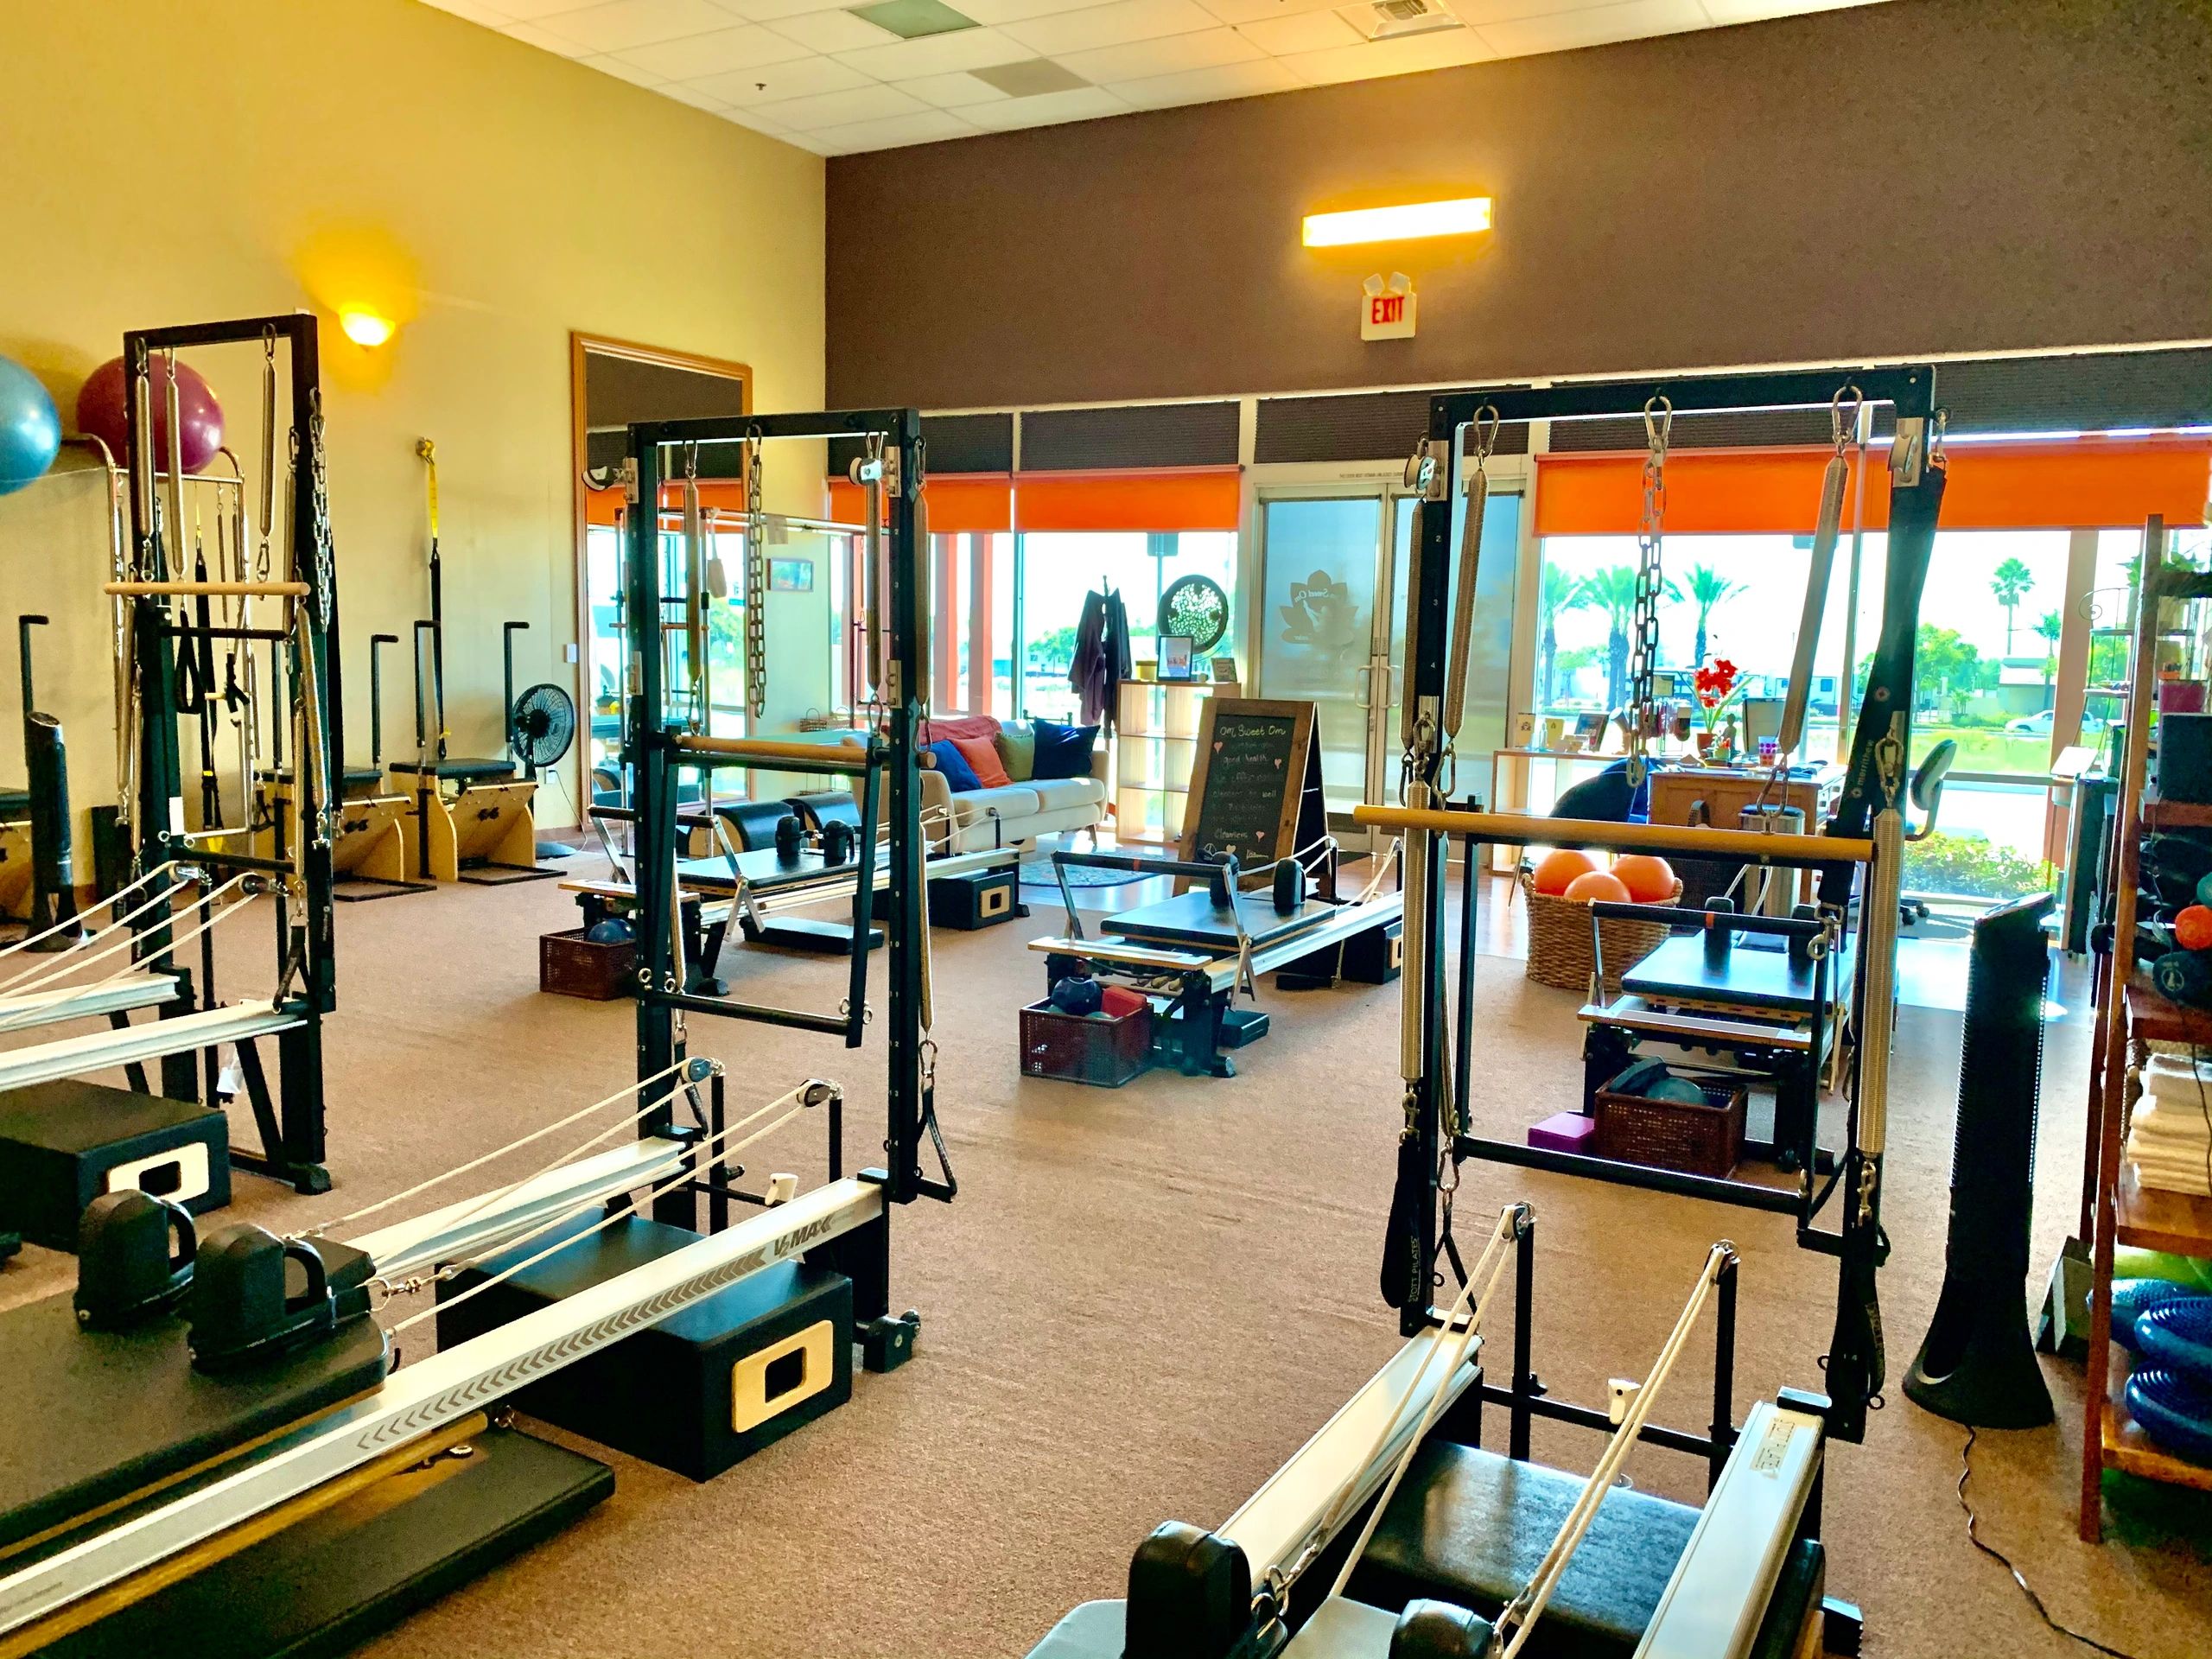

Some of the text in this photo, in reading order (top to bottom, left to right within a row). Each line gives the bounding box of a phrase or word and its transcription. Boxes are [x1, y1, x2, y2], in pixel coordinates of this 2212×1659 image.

[1372, 296, 1405, 324] EXIT
[1238, 724, 1265, 737] Sweet
[1268, 725, 1287, 735] Om
